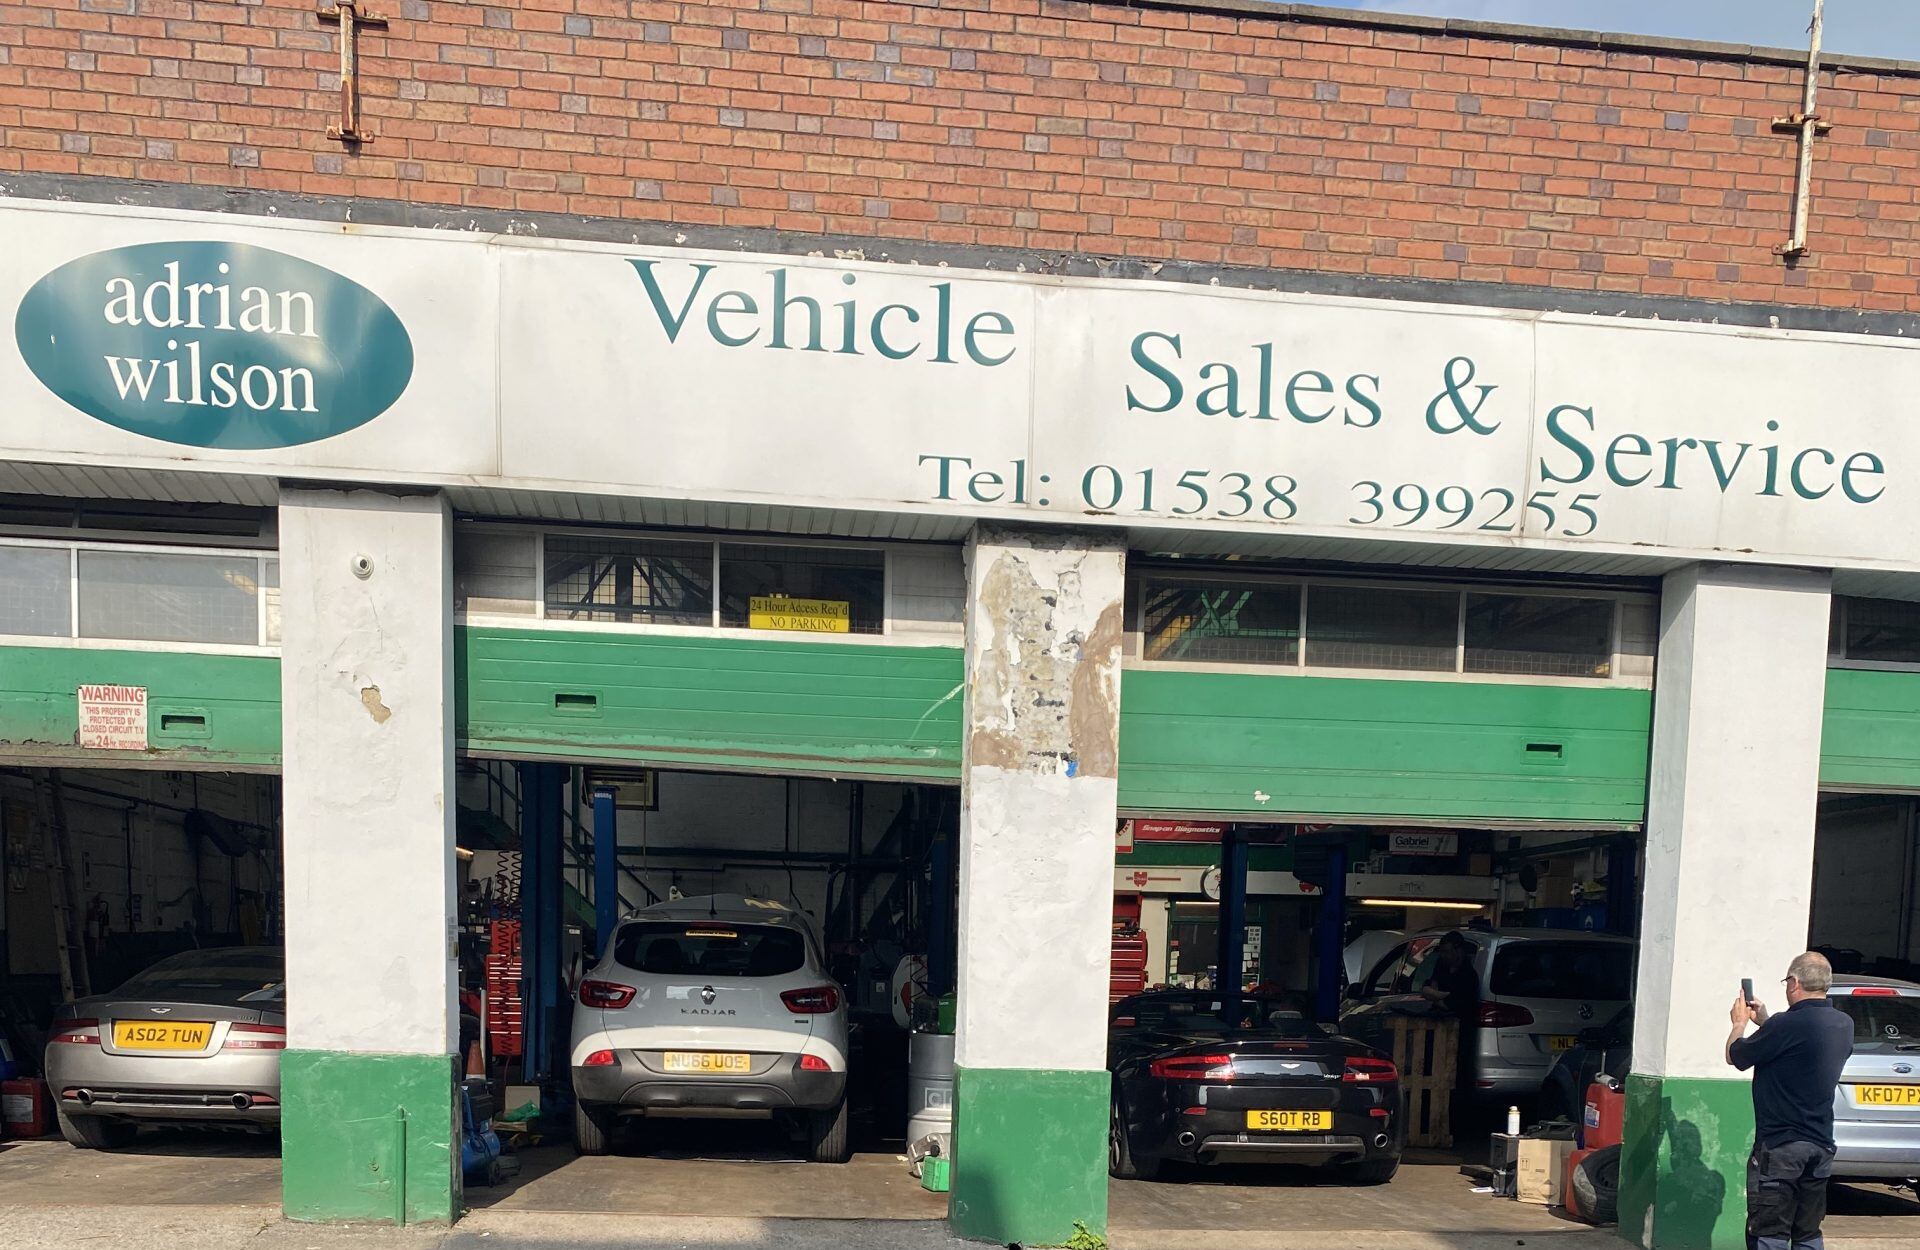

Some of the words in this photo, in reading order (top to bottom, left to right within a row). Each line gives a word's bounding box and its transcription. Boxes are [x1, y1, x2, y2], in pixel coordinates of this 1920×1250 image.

[103, 260, 319, 338] adrian
[103, 340, 319, 412] wilson
[624, 259, 1016, 367] Vehicle
[1126, 331, 1382, 429] Sales
[1425, 356, 1501, 436] &
[1541, 404, 1886, 504] Service
[918, 455, 1051, 507] Tel:
[1081, 464, 1298, 521] 01538
[1349, 480, 1602, 537] 399255
[751, 600, 761, 611] 24
[764, 601, 787, 612] Hour
[789, 602, 818, 614] Access
[770, 616, 785, 628] NO
[790, 617, 837, 631] PARKING
[81, 686, 144, 703] WARNING
[85, 706, 100, 715] THIS
[101, 707, 133, 716] PROPERTY
[134, 708, 141, 717] IS
[89, 716, 126, 725] PROTECTED
[127, 717, 136, 725] BY
[82, 725, 107, 734] CLOSED
[108, 726, 133, 735] CIRCUIT
[1174, 825, 1221, 834] Diagnostics
[1395, 836, 1430, 847] Gabriel
[680, 1008, 737, 1016] KADJAR
[172, 1030, 203, 1044] TUN
[671, 1054, 710, 1068] NU66
[715, 1054, 745, 1068] UOE
[1862, 1087, 1903, 1102] KF07
[1302, 1112, 1321, 1126] RB
